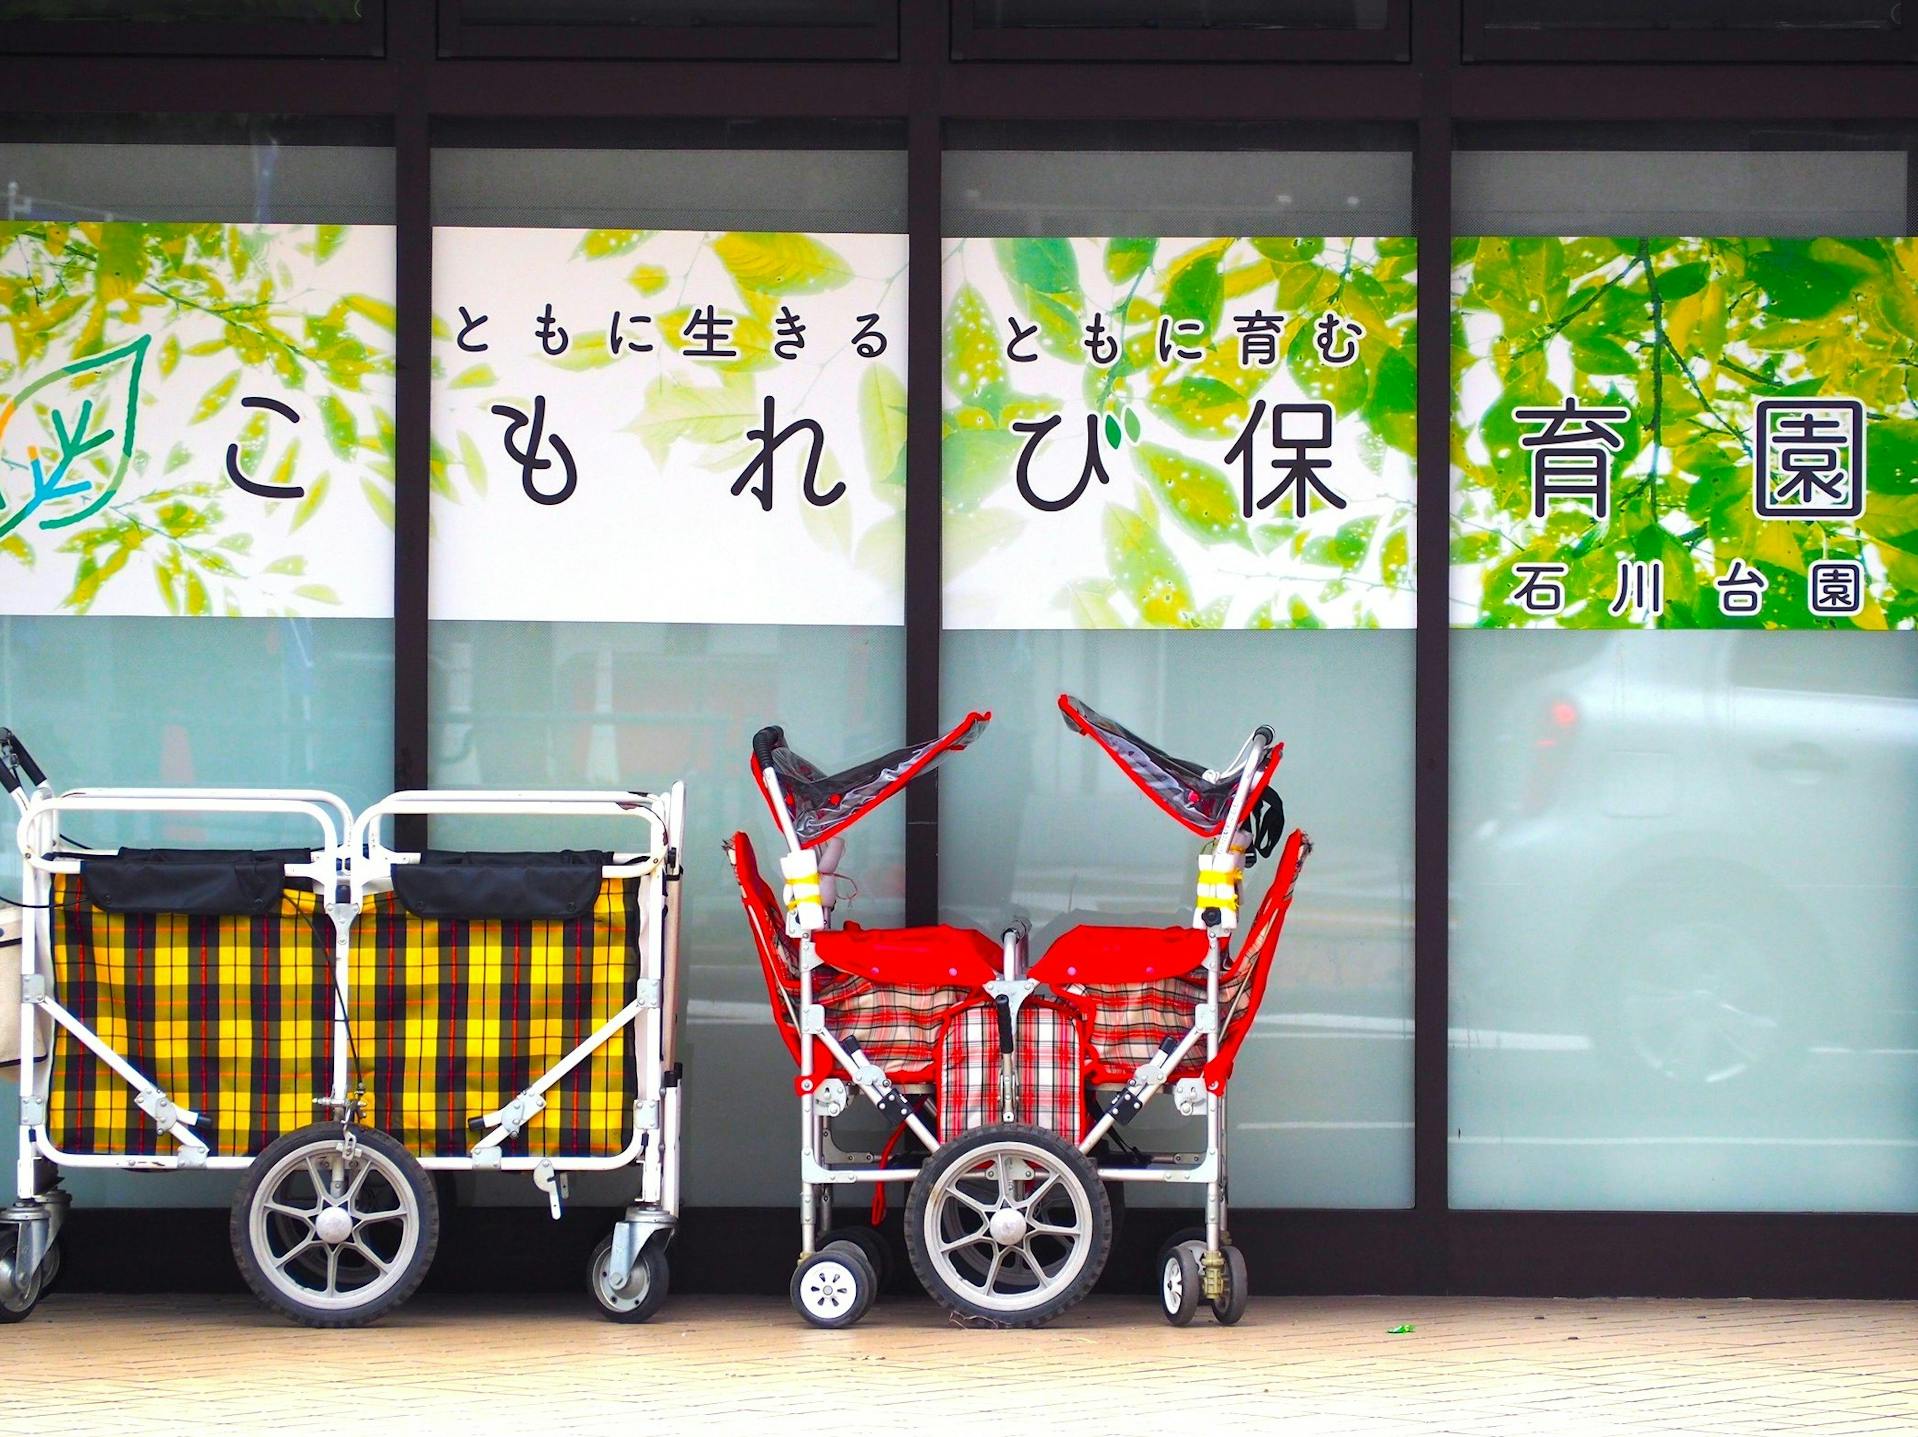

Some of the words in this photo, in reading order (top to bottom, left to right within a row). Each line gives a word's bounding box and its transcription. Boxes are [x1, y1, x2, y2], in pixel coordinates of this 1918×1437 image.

[457, 304, 889, 358] ともに生きる
[1006, 310, 1363, 365] ともに育む
[226, 396, 1864, 518] こもれび保育園
[1514, 562, 1862, 613] 石川台園
